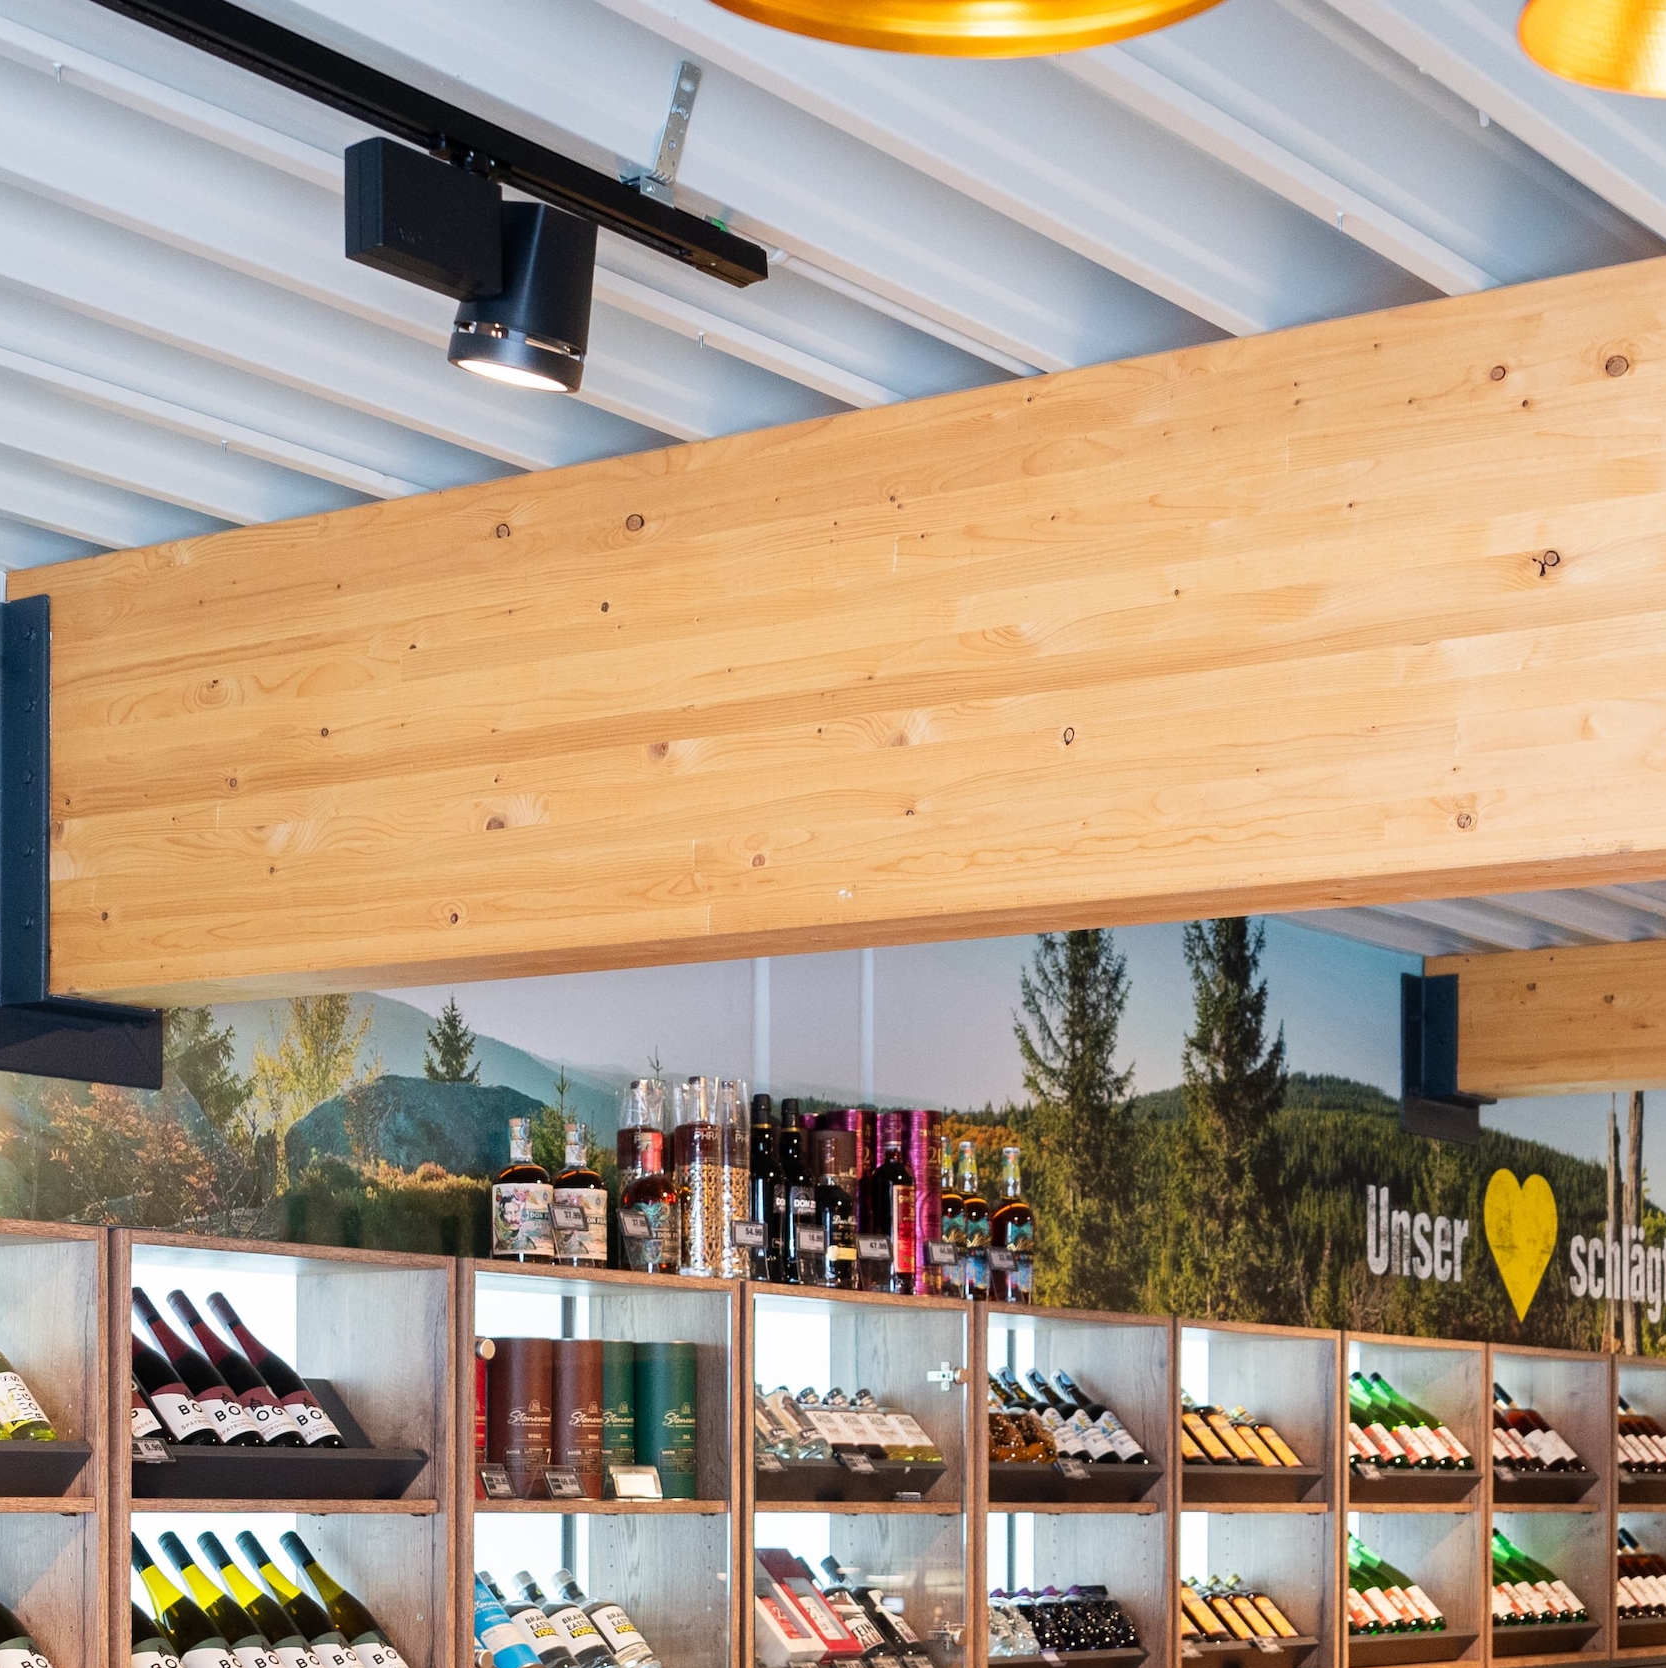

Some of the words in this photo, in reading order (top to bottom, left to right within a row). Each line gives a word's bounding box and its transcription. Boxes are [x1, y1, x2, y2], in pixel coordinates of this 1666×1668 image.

[694, 1131, 721, 1142] PHRA
[1366, 1184, 1469, 1283] Unser
[177, 1402, 204, 1416] BO
[214, 1405, 241, 1422] BO
[256, 1406, 284, 1422] OG
[296, 1409, 323, 1427] BO
[144, 1443, 163, 1453] 8.99
[534, 1628, 557, 1638] VODK
[615, 1624, 637, 1634] VODK
[861, 1631, 882, 1649] ALD
[333, 1651, 357, 1666] BO
[372, 1649, 398, 1665] BO
